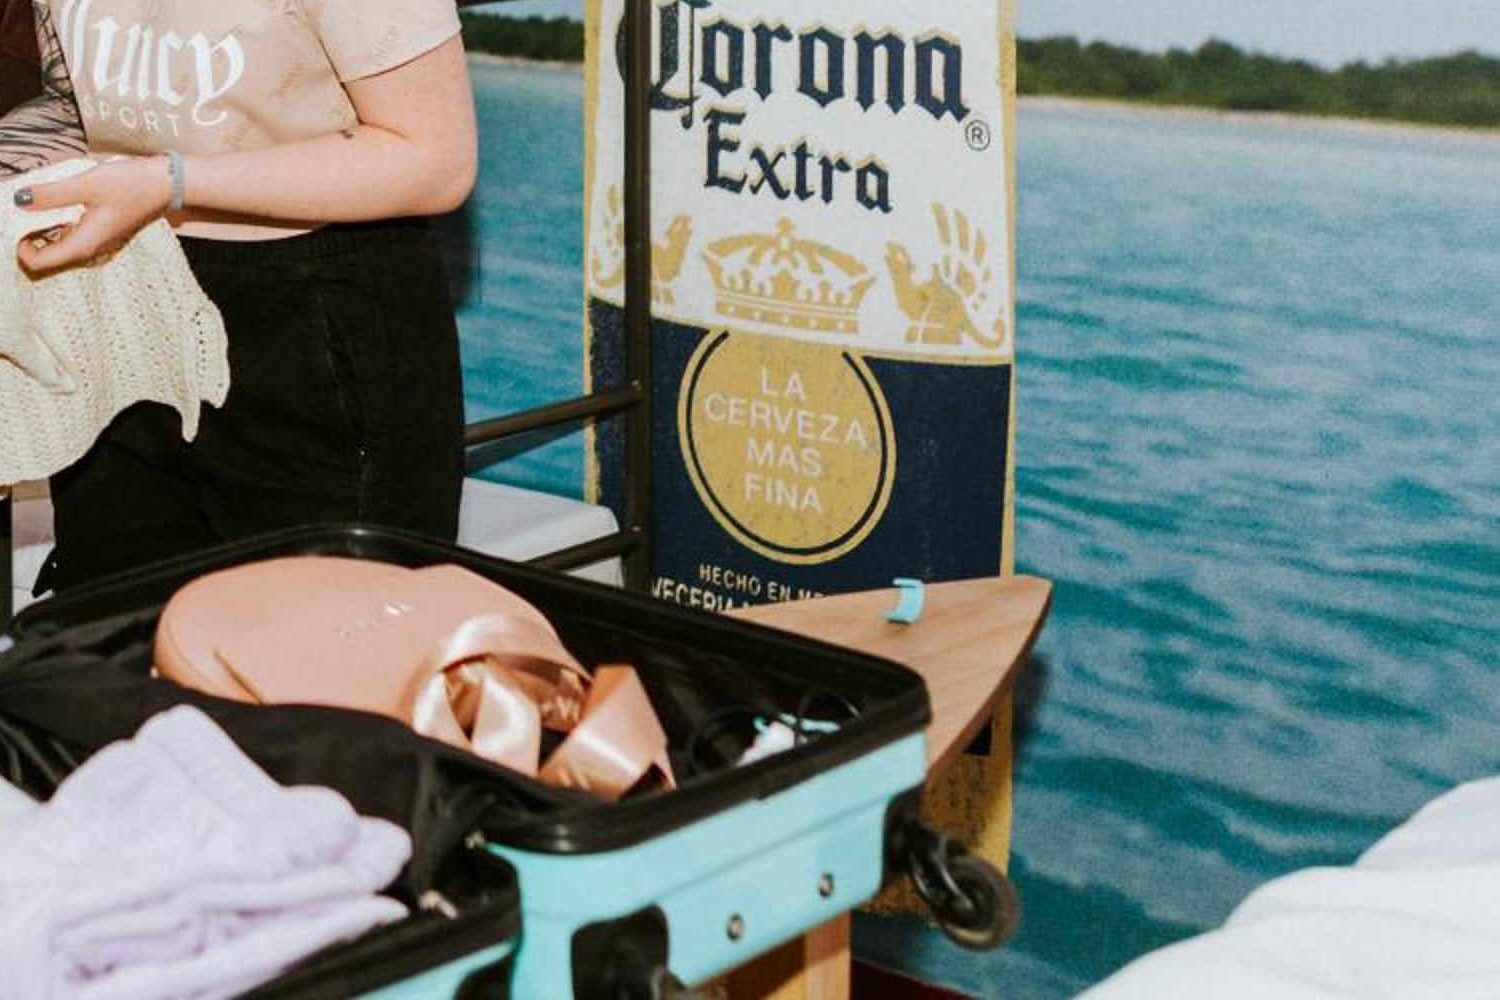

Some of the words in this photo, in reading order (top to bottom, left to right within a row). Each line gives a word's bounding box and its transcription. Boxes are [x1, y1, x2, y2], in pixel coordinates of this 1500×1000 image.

[82, 93, 181, 137] SPORT
[703, 107, 893, 214] Extra
[761, 367, 805, 400] LA
[704, 391, 870, 448] CERVEZA
[745, 438, 822, 477] MAS
[745, 471, 822, 515] FINA
[700, 563, 761, 596] HECHO
[767, 580, 791, 602] EN
